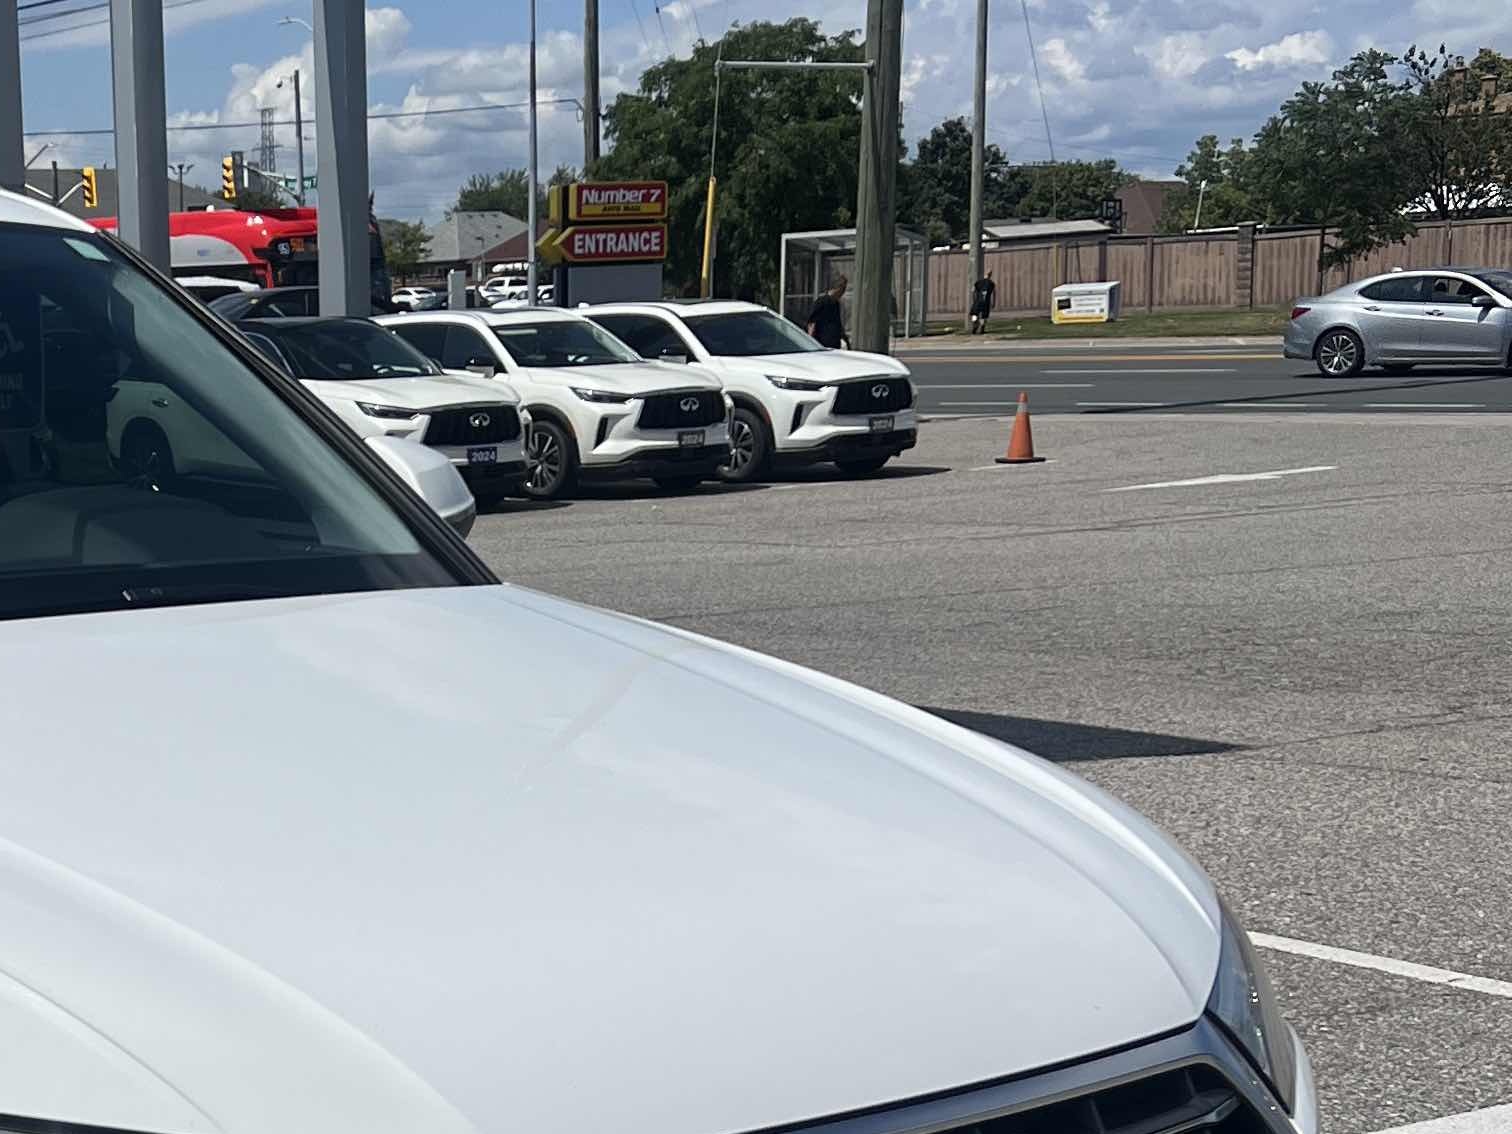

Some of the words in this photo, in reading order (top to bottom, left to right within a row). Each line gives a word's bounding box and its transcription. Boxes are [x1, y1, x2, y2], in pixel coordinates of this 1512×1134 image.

[582, 188, 647, 204] Number
[649, 189, 662, 203] 7
[574, 231, 661, 255] ENTRANCE
[471, 451, 496, 462] 2024
